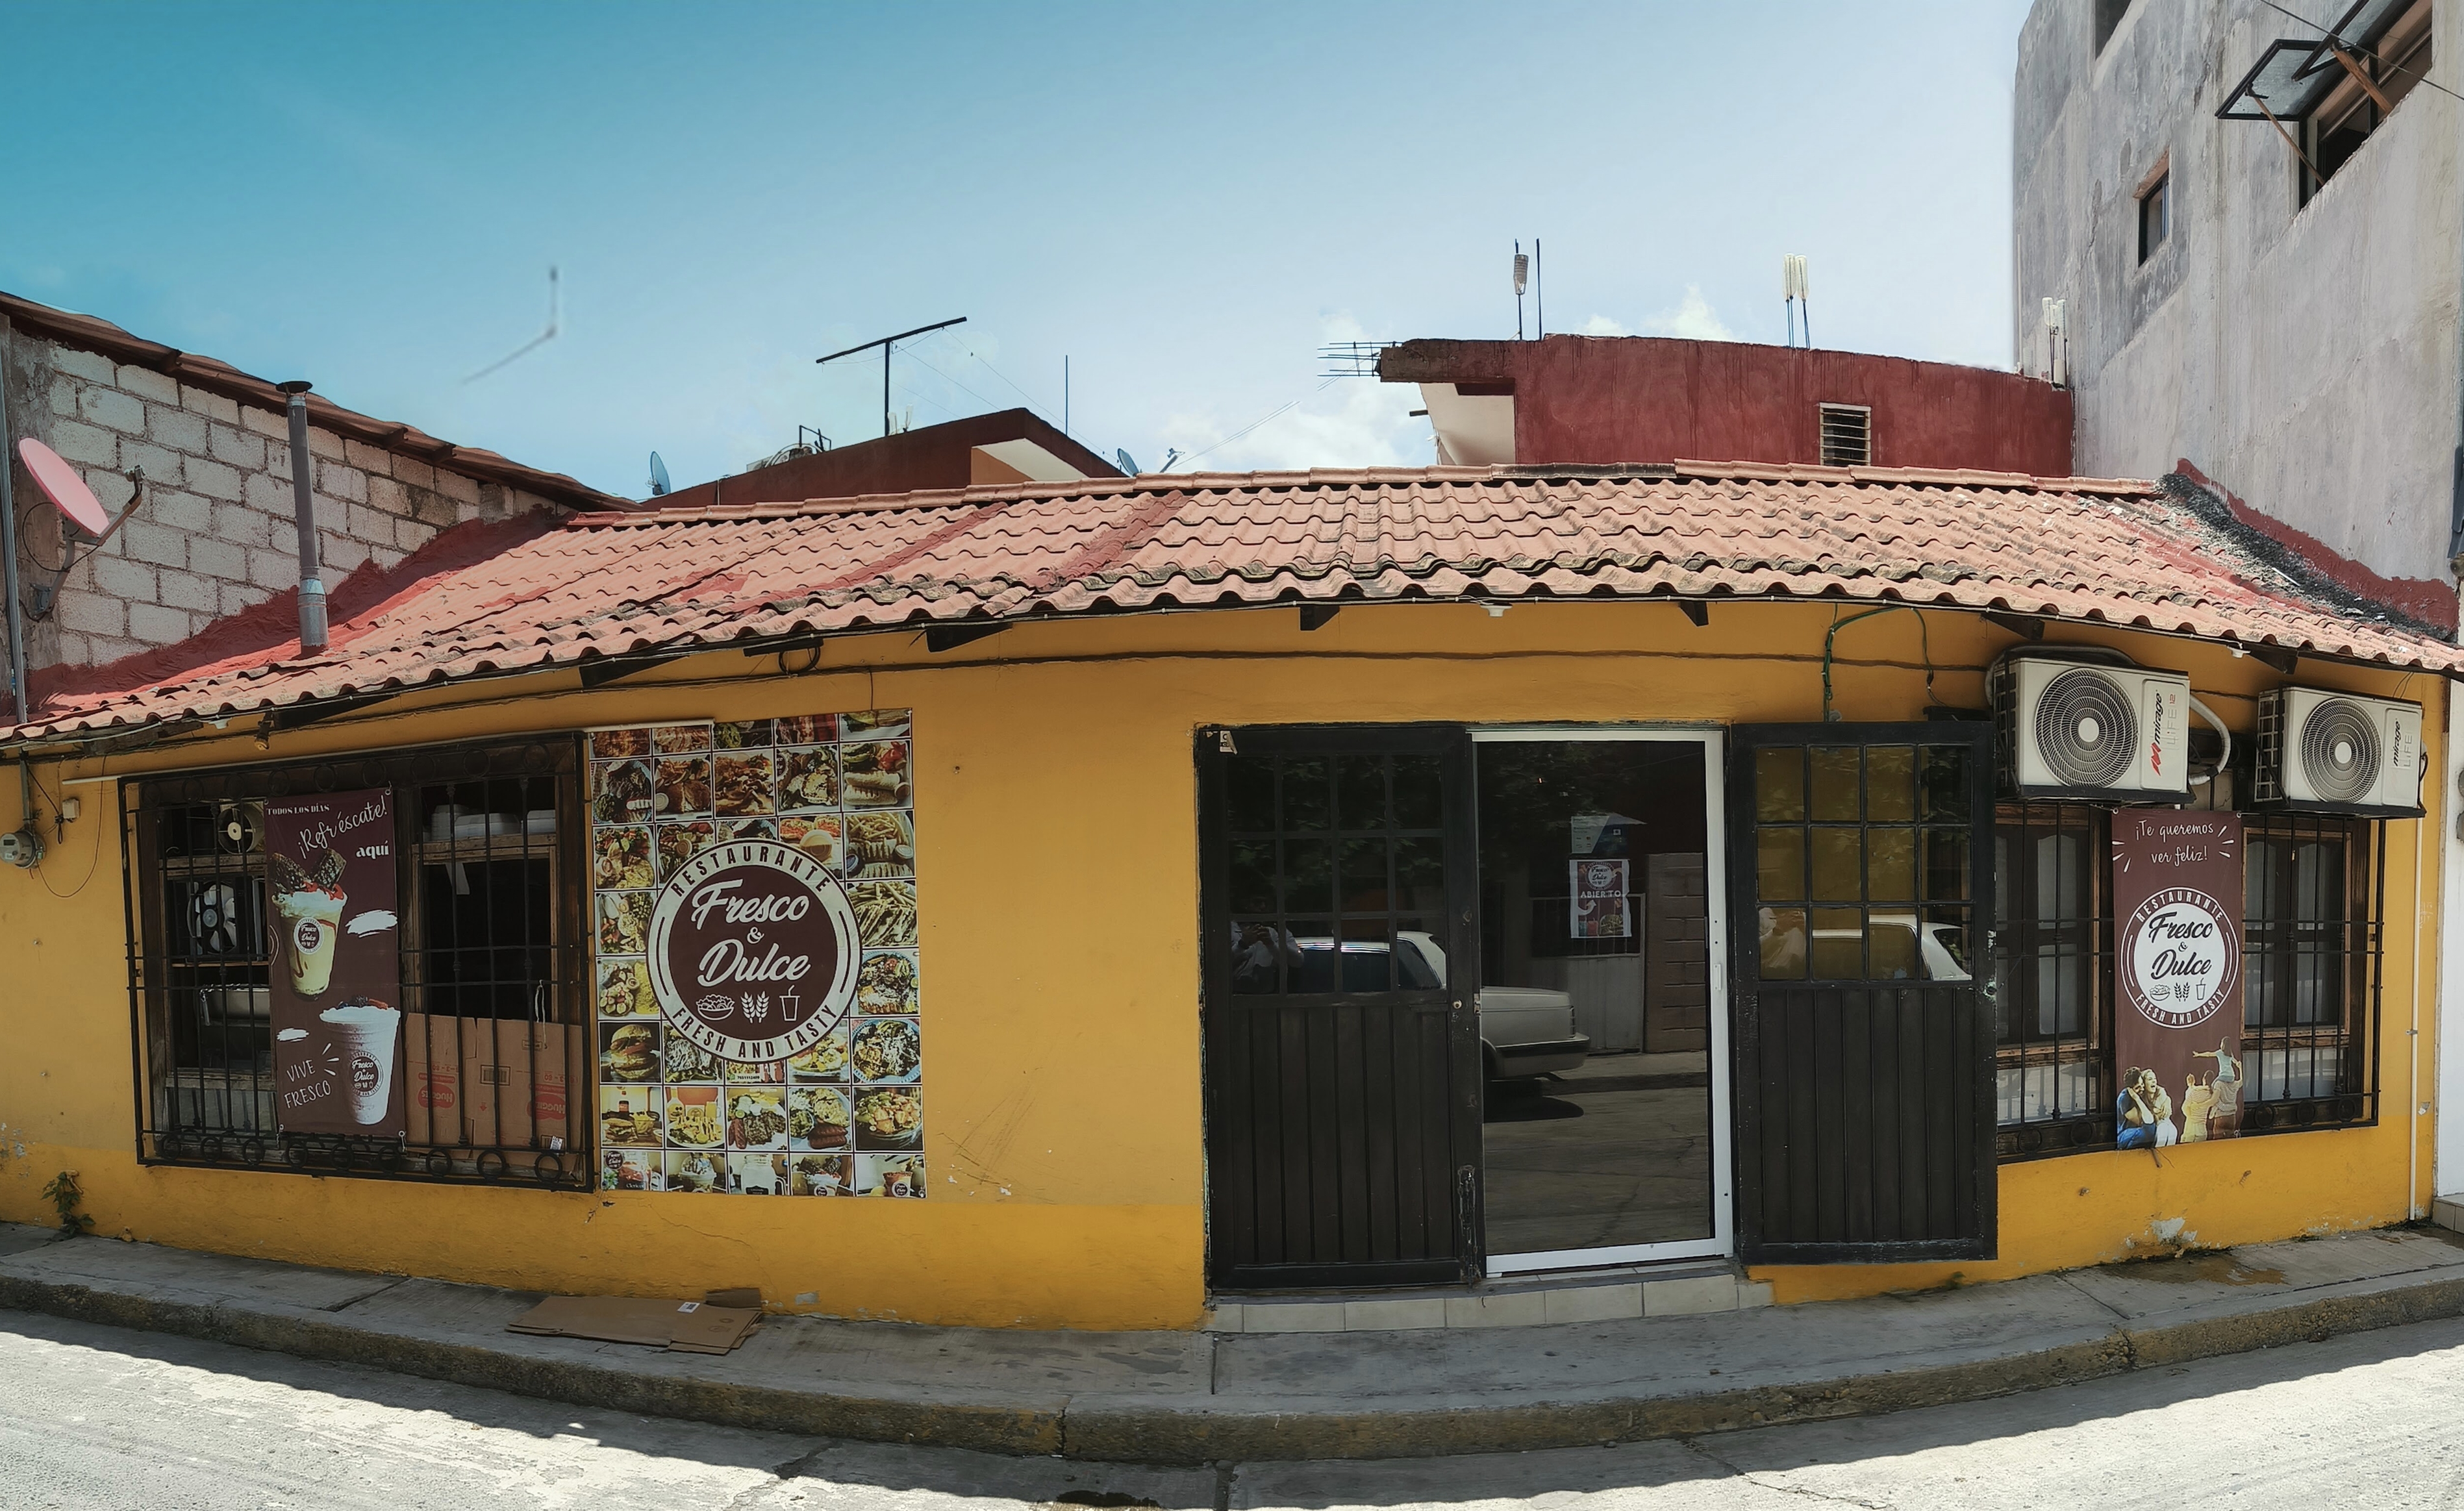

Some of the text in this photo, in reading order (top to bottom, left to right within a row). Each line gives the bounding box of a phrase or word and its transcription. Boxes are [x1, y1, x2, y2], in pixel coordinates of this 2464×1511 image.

[2154, 693, 2163, 745] mirage
[311, 803, 330, 812] DÍAS
[2159, 823, 2214, 843] queremos
[356, 840, 390, 859] aquí
[2151, 845, 2208, 867] ver feliz!
[670, 845, 831, 897] RESTAURANTE
[691, 878, 810, 930] Fresco
[2135, 890, 2223, 923] RESTAURANTE
[747, 927, 765, 944] &
[2148, 912, 2213, 943] Fresco
[2178, 942, 2188, 952] &
[697, 939, 811, 987] Dulce
[2150, 949, 2212, 980] Dulce
[2135, 988, 2225, 1025] FRESH AND TASTY
[672, 1005, 837, 1058] FRESH AND TASTY
[286, 1060, 316, 1082] VIVE
[354, 1071, 375, 1082] Dulce
[284, 1080, 331, 1108] FRESCO
